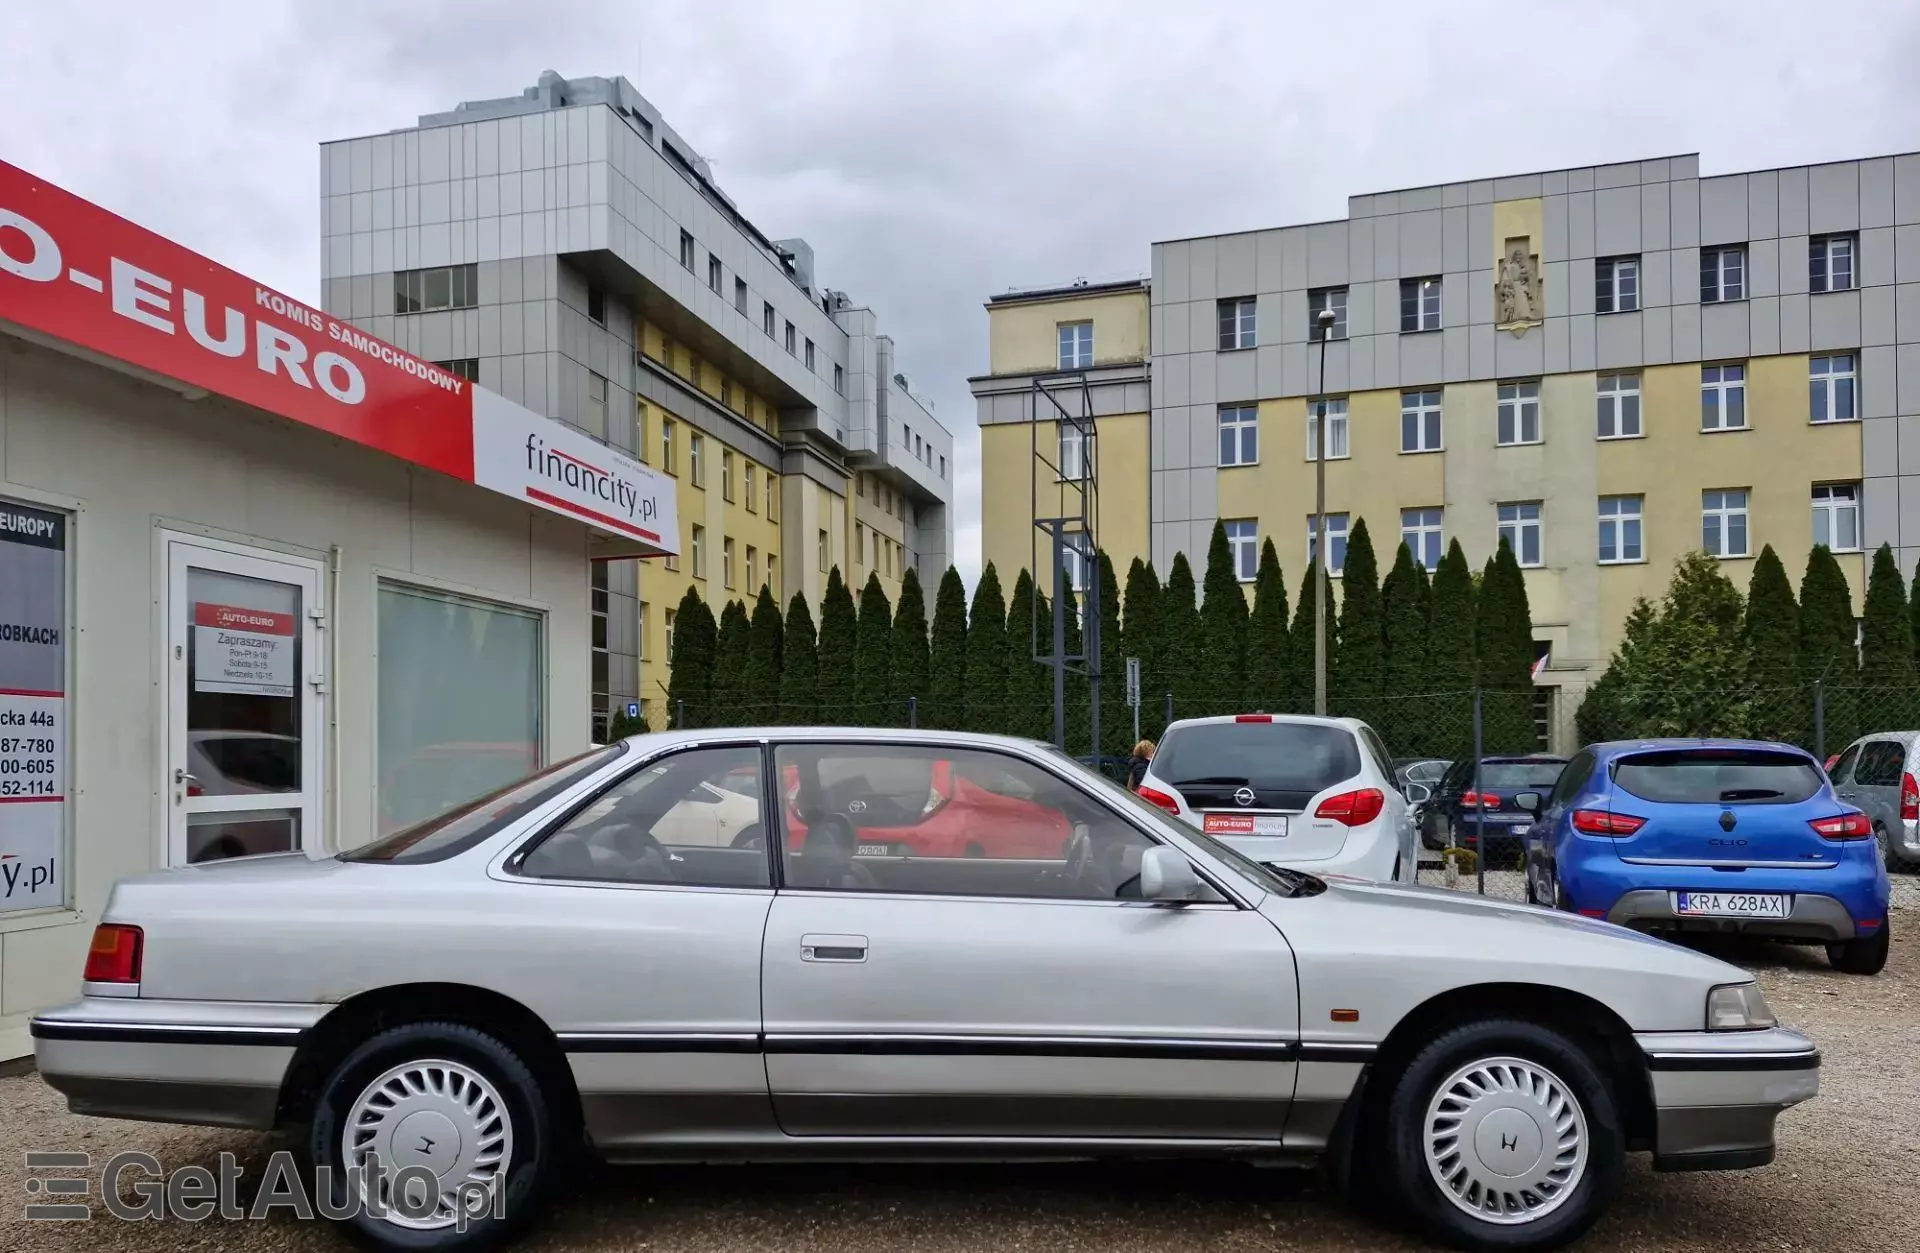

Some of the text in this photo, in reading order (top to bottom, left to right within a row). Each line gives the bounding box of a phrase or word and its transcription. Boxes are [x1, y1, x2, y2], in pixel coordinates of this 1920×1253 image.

[256, 287, 462, 395] KOMIS SAMOCHODOWY
[526, 433, 657, 522] financity.pl
[0, 511, 55, 538] EUROPY
[222, 612, 274, 627] AUTO-EURO
[0, 623, 59, 645] OBKACH
[0, 709, 54, 726] cka 44a
[1, 738, 54, 753] 87-780
[0, 759, 54, 774] 00-605
[1688, 895, 1780, 912] KRA 628AX
